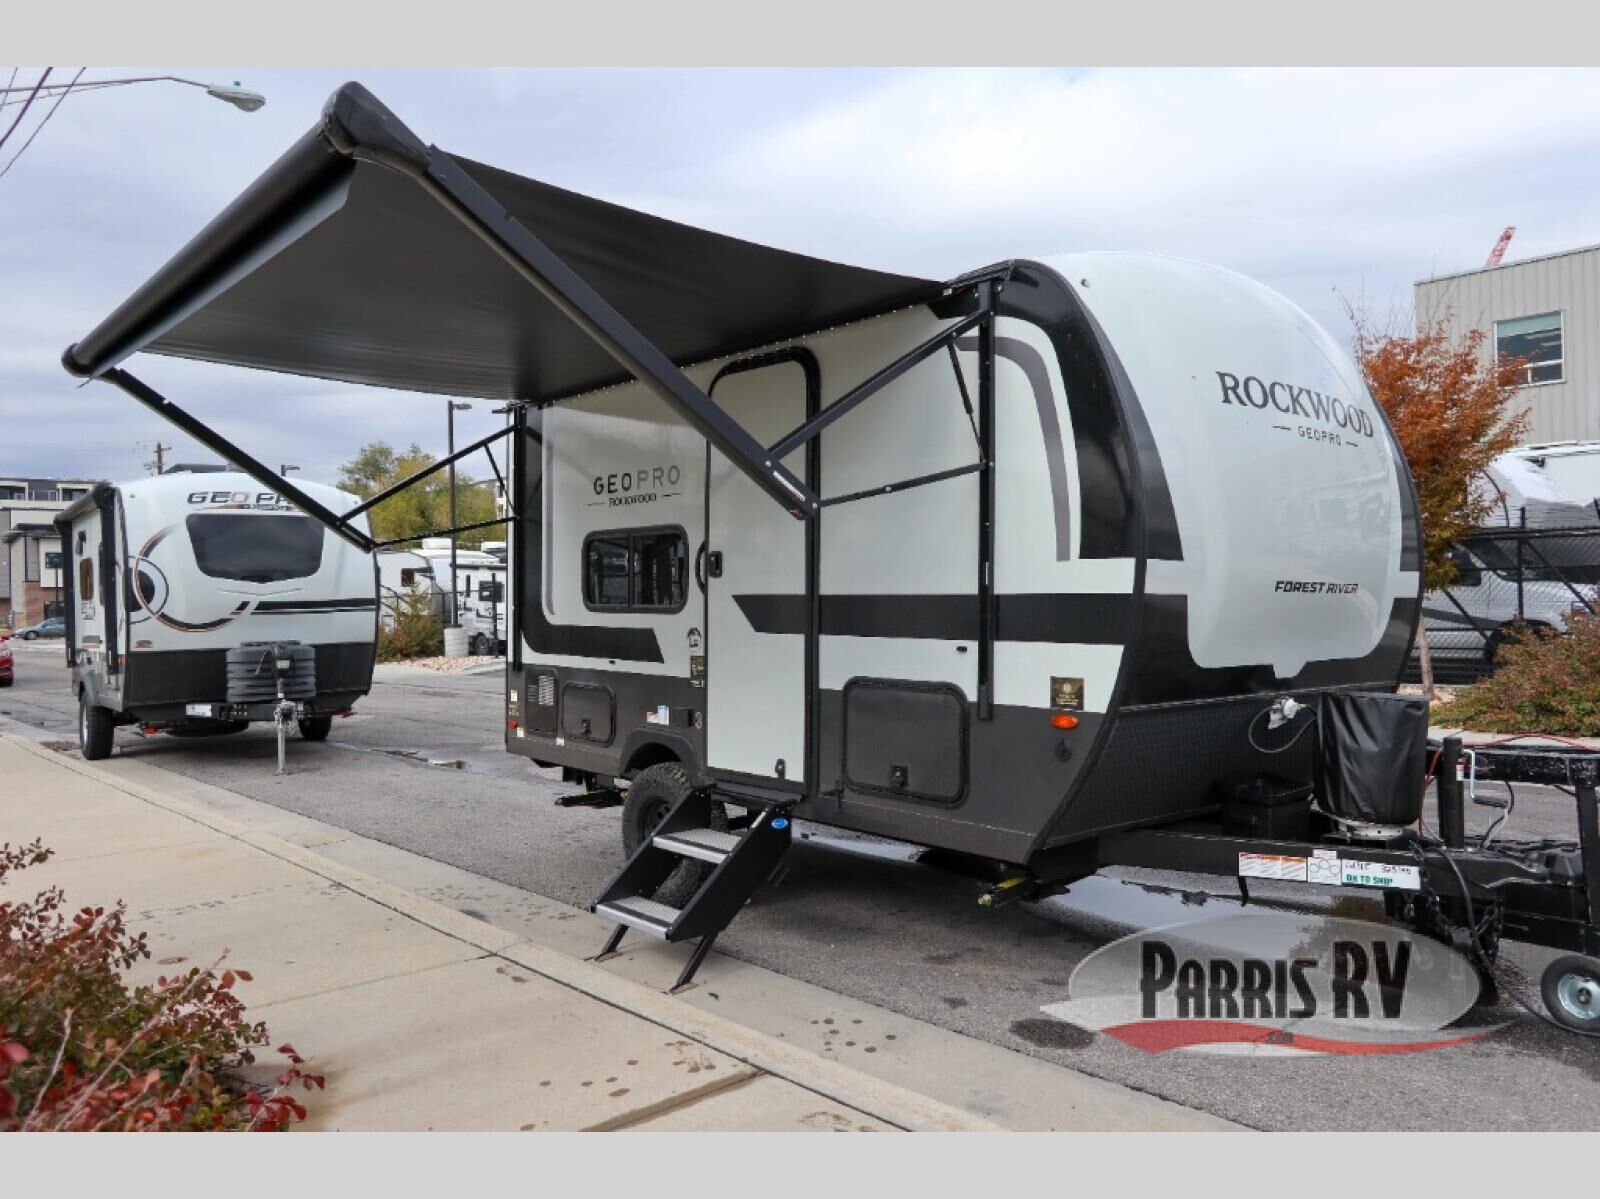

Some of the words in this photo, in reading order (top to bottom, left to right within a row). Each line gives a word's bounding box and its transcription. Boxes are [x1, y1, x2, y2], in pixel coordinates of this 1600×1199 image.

[1216, 371, 1374, 438] ROCKWOOD
[1298, 425, 1342, 446] GEOPRO
[187, 491, 249, 505] GEO
[1275, 580, 1326, 593] FOREST
[1326, 583, 1359, 594] RIVER
